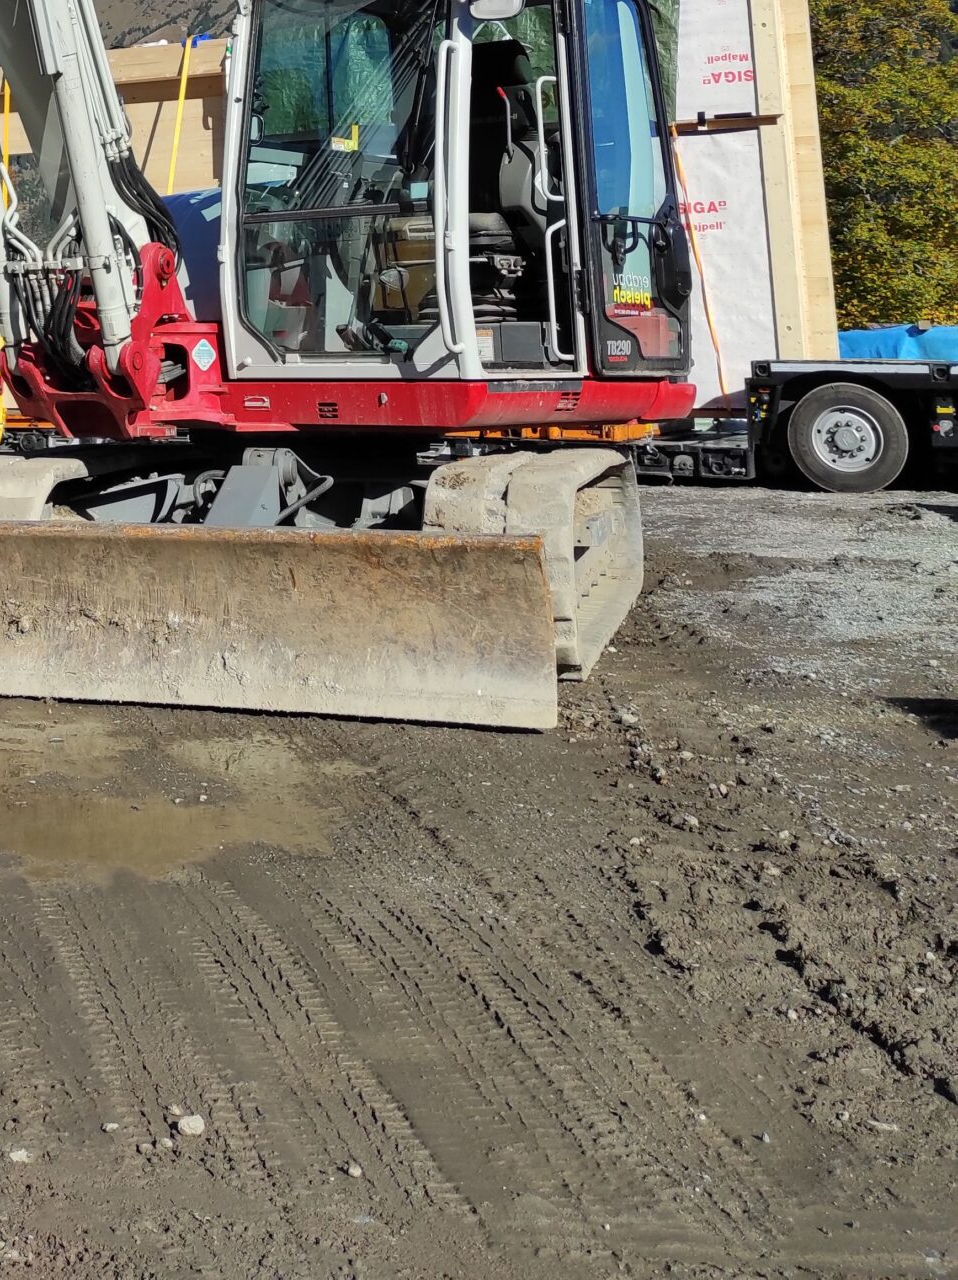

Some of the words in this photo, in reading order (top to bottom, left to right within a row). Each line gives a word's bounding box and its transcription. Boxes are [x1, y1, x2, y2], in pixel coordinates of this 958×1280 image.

[707, 53, 749, 64] Majpell
[711, 70, 754, 84] SIGA
[679, 201, 719, 214] SIGA
[606, 340, 632, 356] TB290
